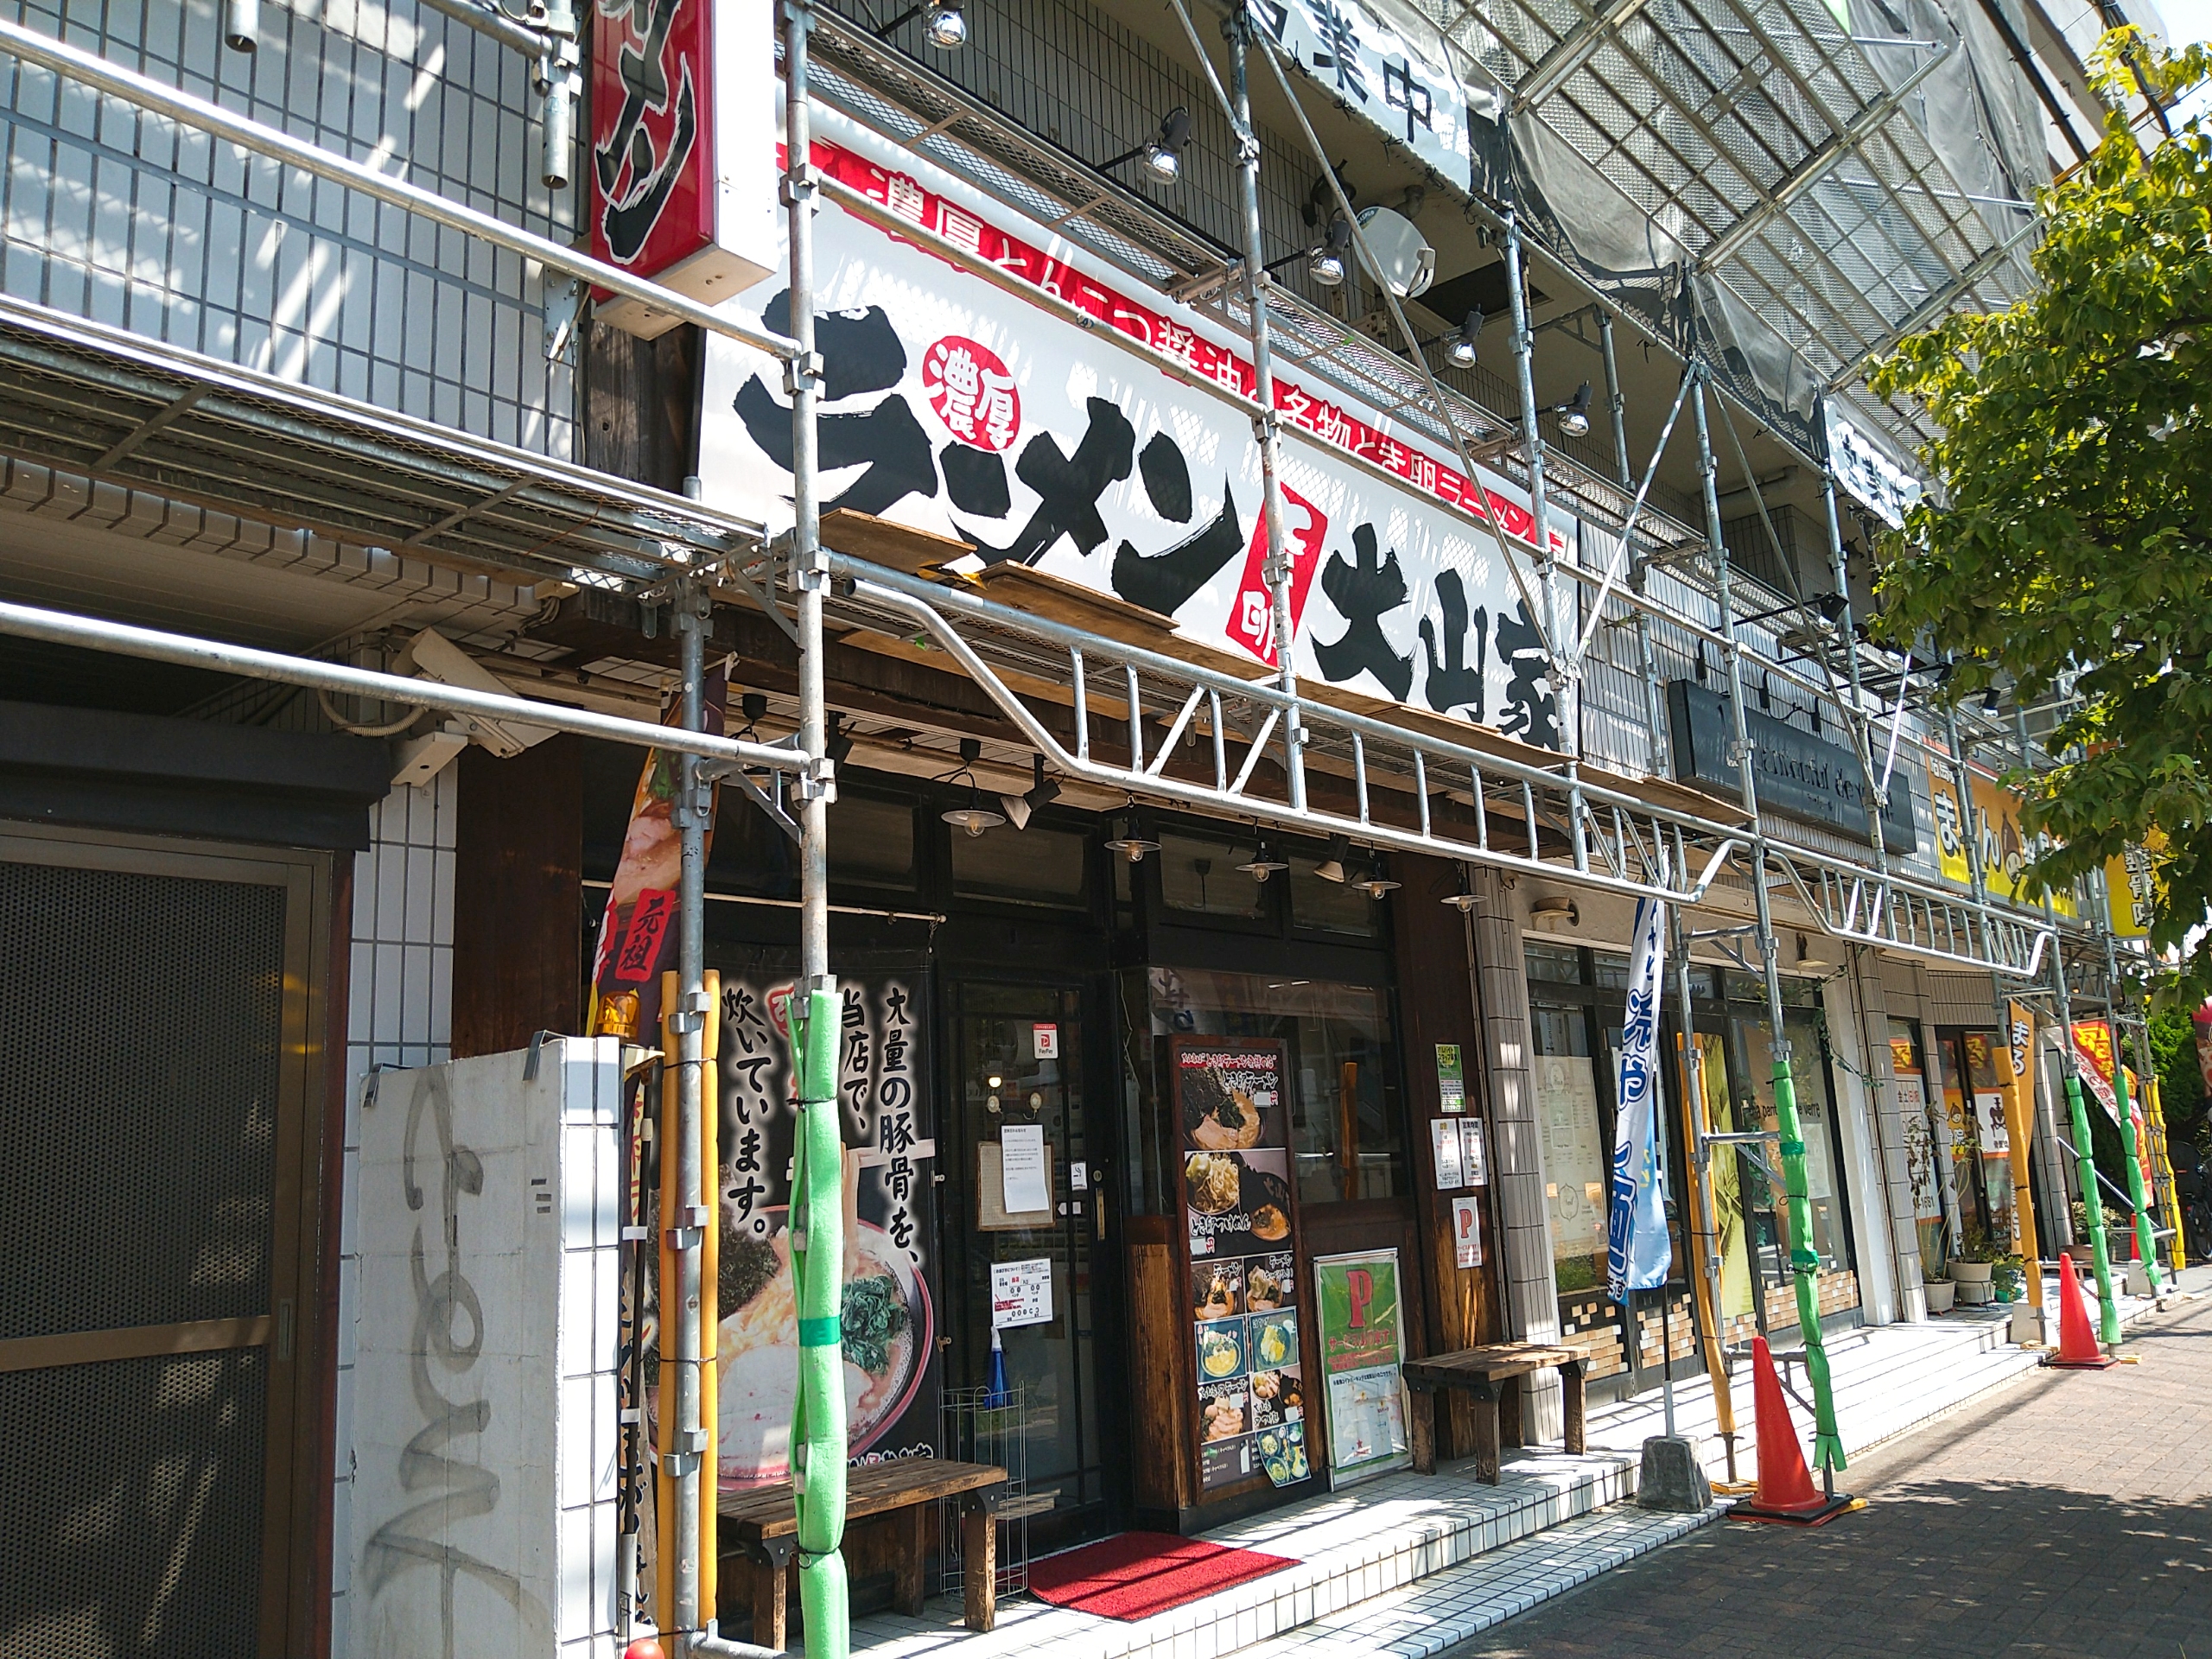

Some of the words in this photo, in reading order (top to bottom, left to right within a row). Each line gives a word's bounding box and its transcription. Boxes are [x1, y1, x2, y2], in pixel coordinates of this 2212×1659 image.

[928, 346, 1018, 447] 濃厚
[620, 896, 665, 972] 元祖
[841, 988, 868, 1129] 当店で、
[721, 987, 772, 1234] 炊いています。
[880, 987, 918, 1264] 大量の豚骨を、
[1459, 1209, 1472, 1238] P
[1213, 1262, 1242, 1278] ラーメン
[1346, 1269, 1373, 1328] P
